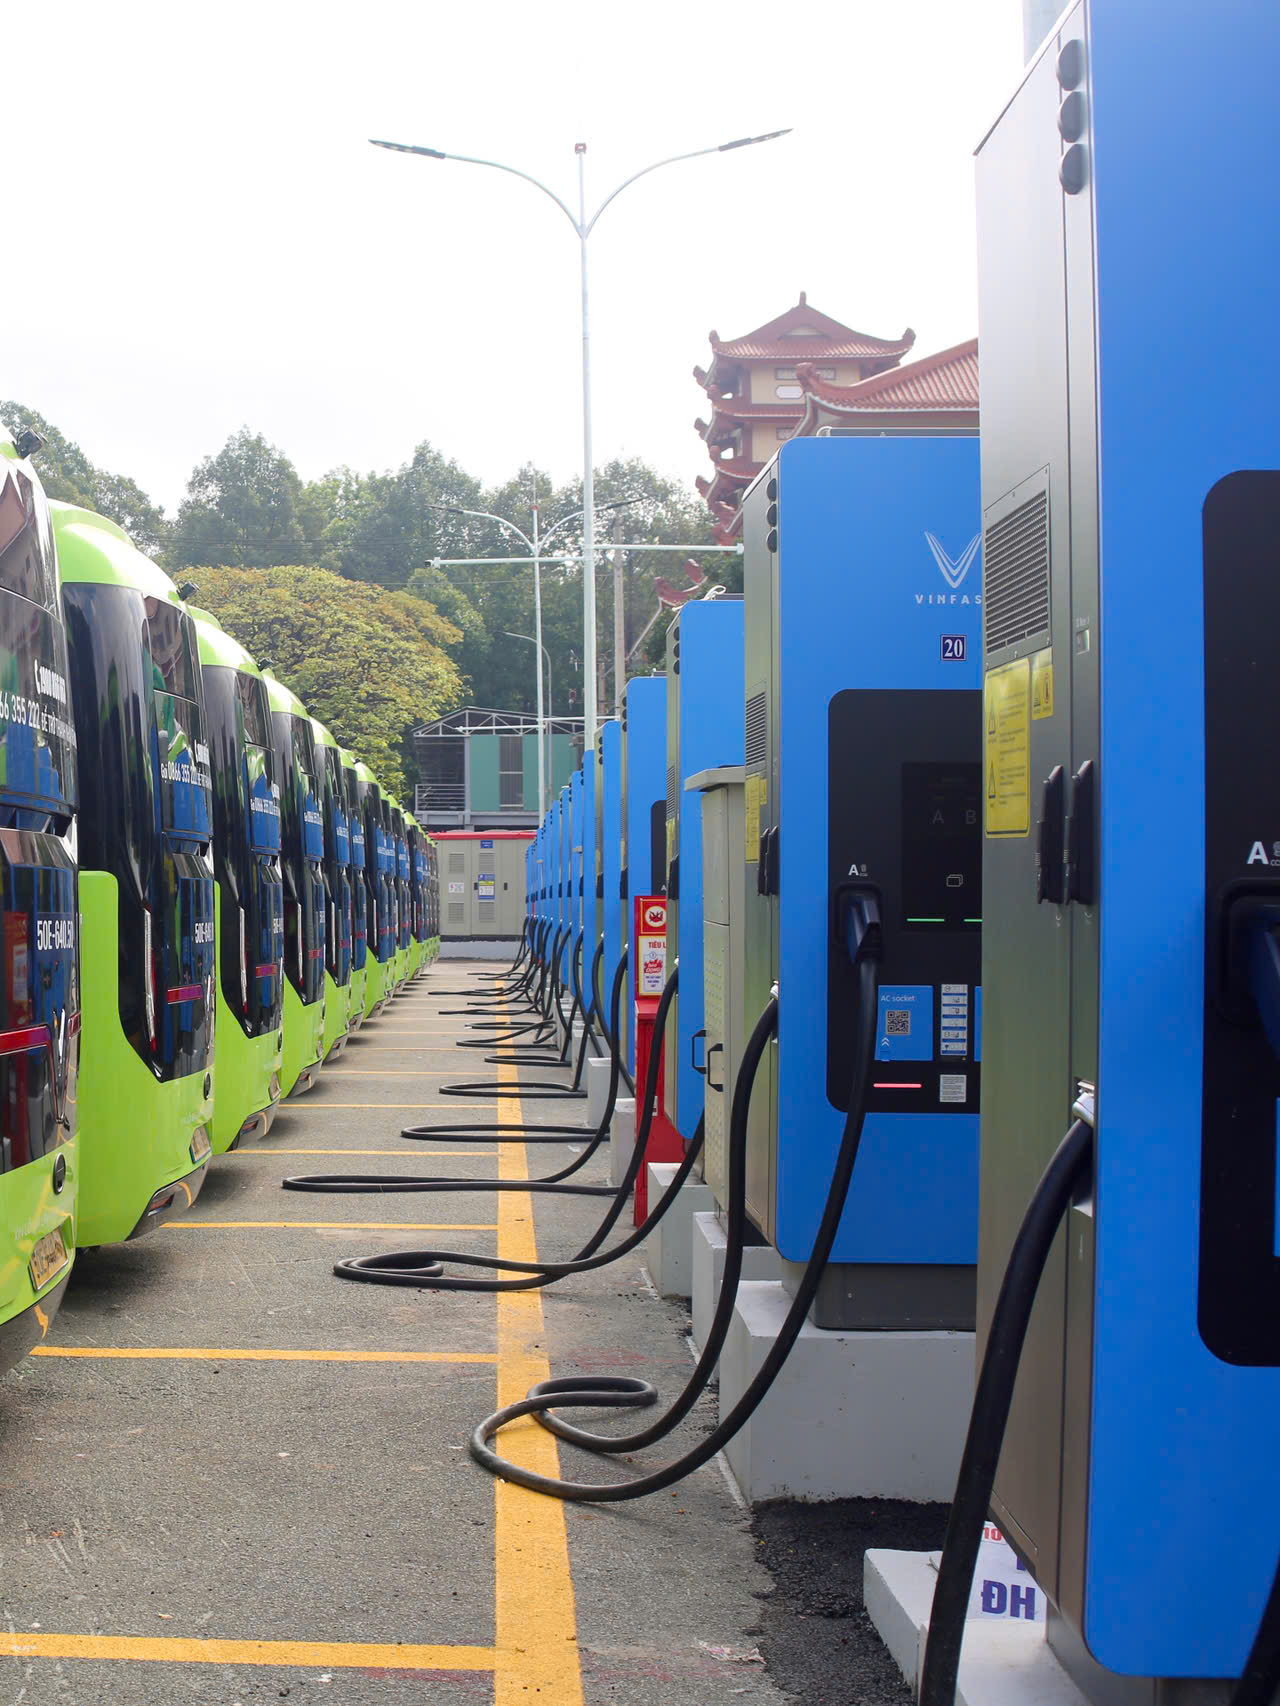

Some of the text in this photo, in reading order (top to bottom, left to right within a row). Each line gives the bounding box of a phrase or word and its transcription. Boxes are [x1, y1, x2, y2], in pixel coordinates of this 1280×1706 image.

[944, 638, 963, 658] 20
[11, 694, 27, 725] 355
[1247, 841, 1269, 865] A
[848, 864, 859, 876] A
[981, 1579, 1036, 1620] ĐH
